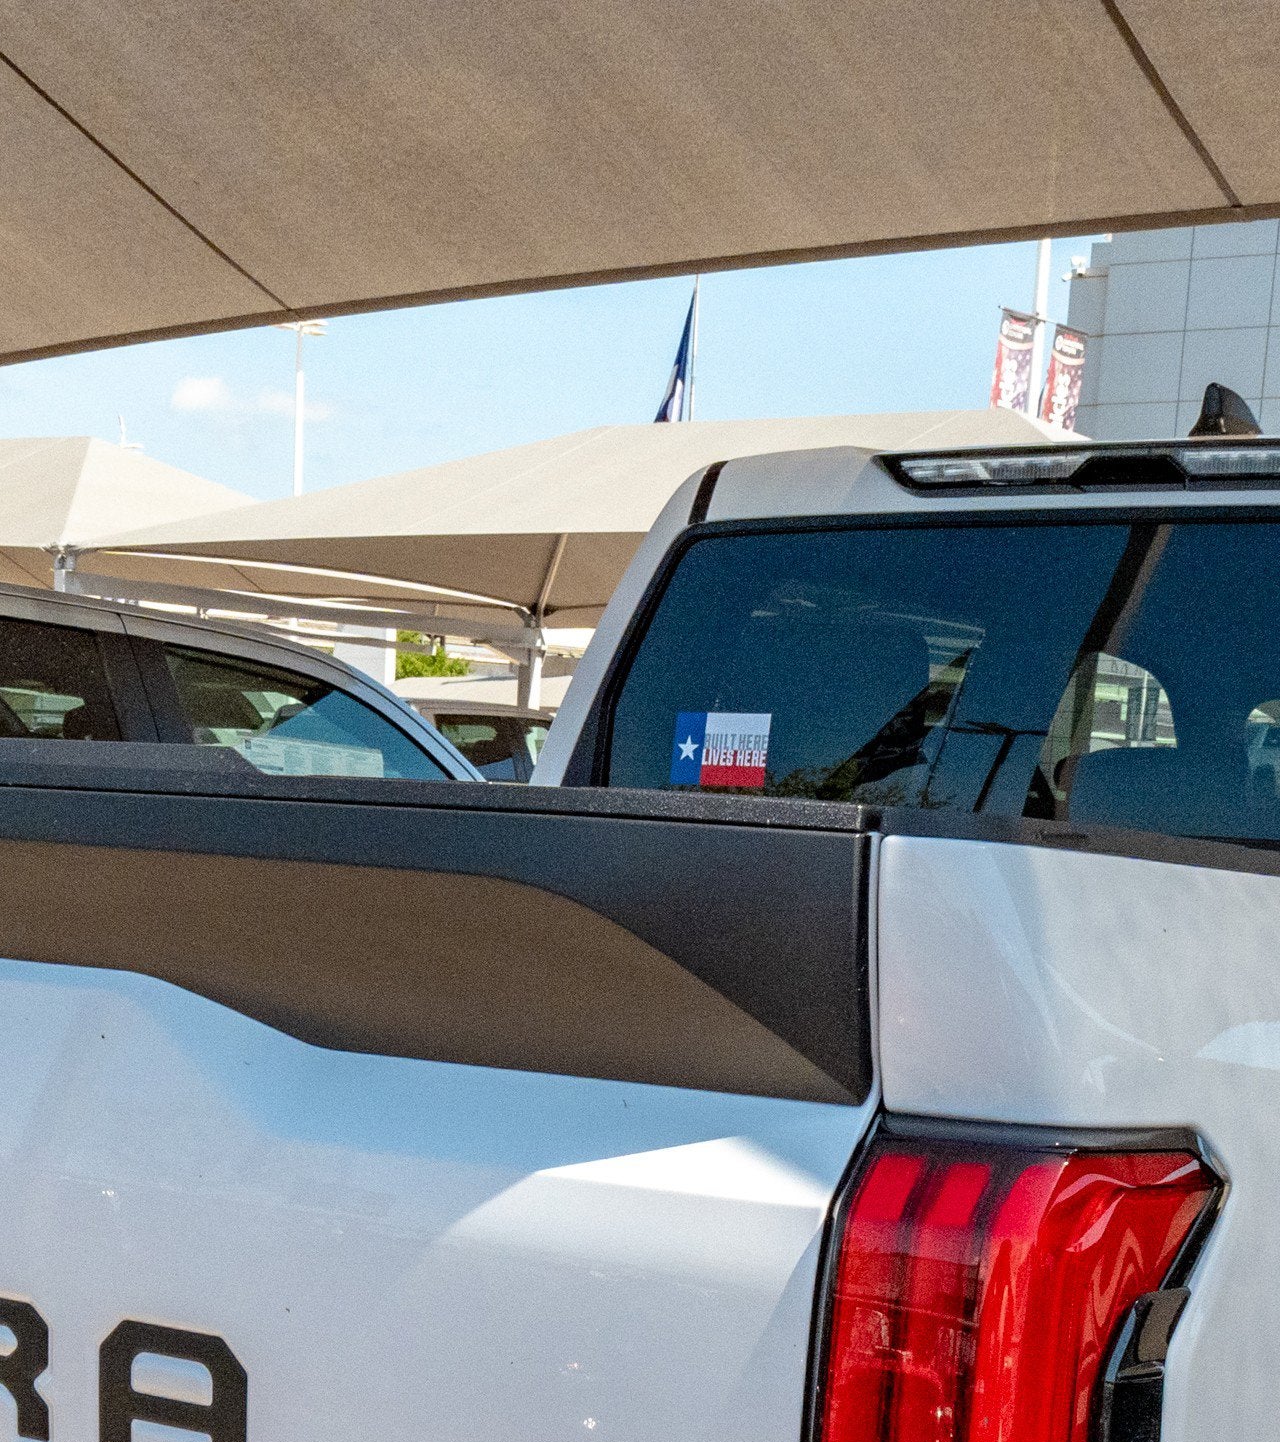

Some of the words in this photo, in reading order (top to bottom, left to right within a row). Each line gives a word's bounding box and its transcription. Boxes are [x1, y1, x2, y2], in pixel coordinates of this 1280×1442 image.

[738, 734, 769, 751] HERE
[701, 749, 735, 767] LIVES
[736, 750, 767, 768] HERE
